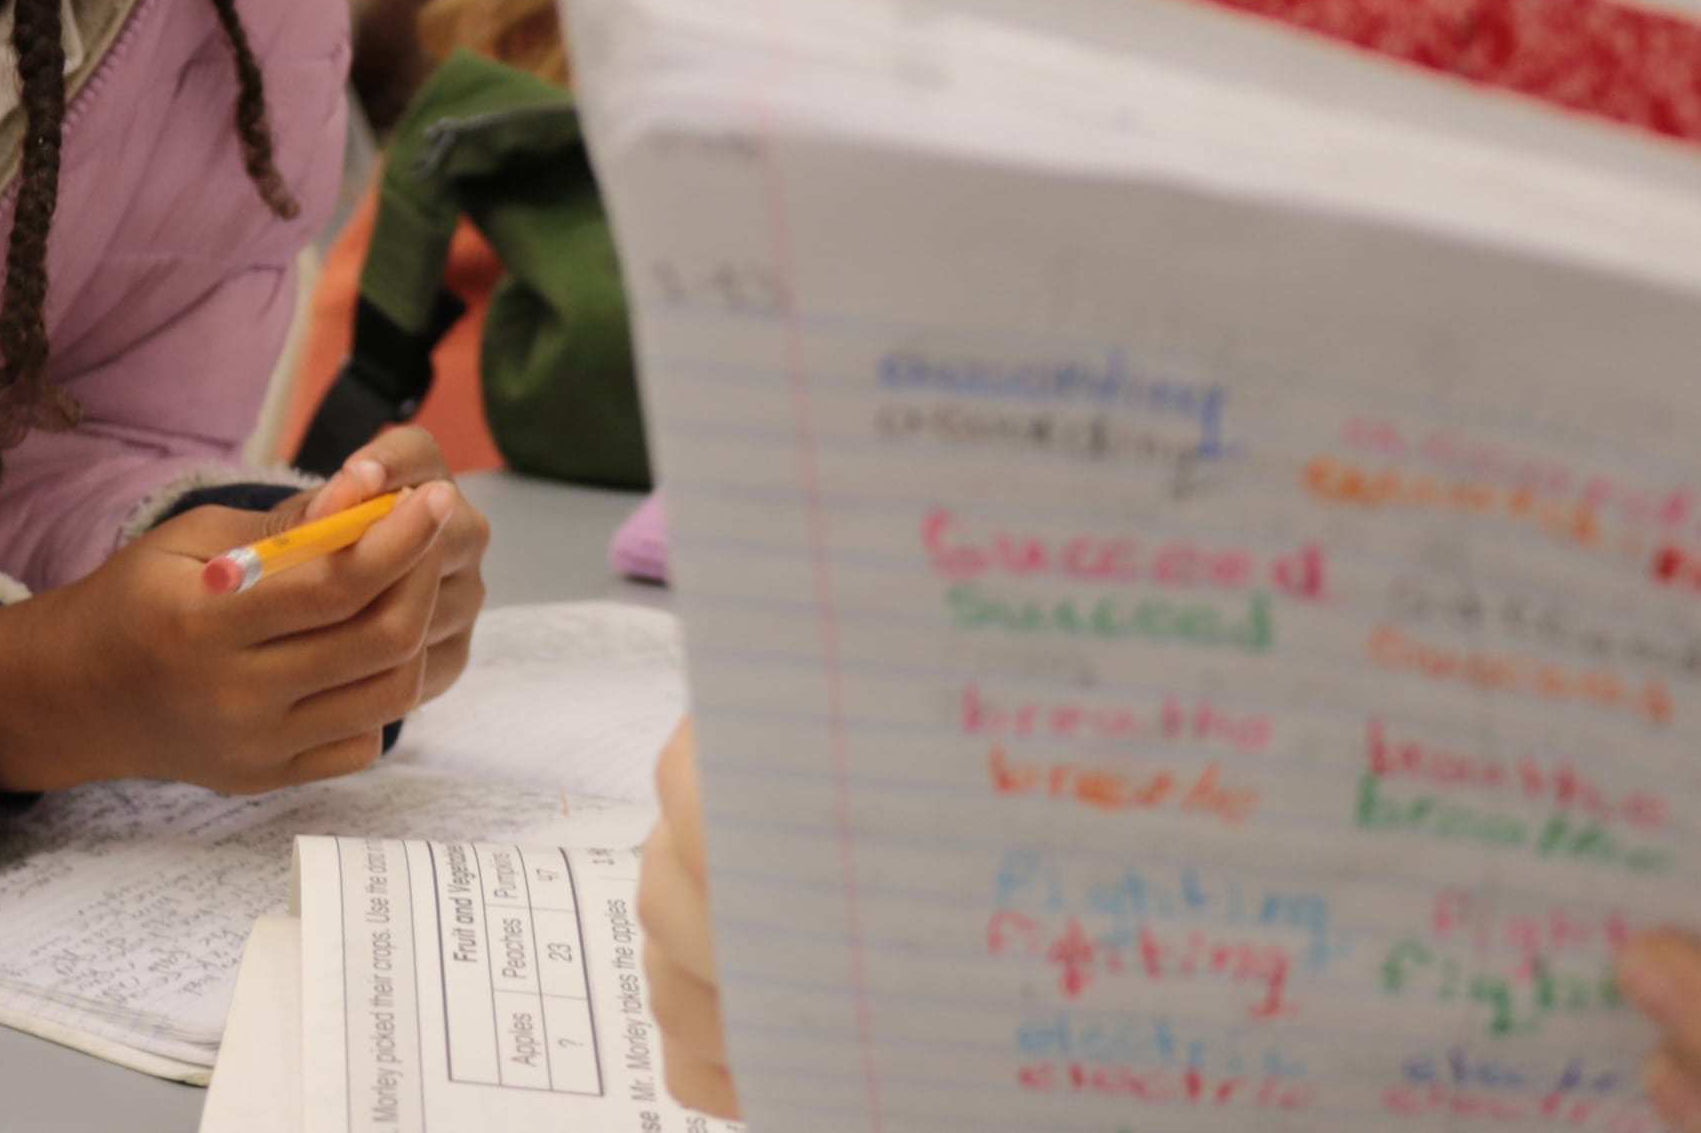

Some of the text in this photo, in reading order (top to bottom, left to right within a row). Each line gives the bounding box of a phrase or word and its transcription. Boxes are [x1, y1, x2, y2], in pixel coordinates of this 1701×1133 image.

[364, 875, 388, 895] the
[365, 897, 390, 923] Use
[452, 896, 474, 926] and
[604, 898, 638, 944] apples
[372, 927, 398, 972] crops.
[452, 928, 479, 963] Fruit
[500, 917, 527, 980] Peaches
[547, 941, 573, 963] 23
[611, 942, 635, 971] the
[367, 976, 394, 1008] their
[616, 973, 644, 1015] takes
[369, 1011, 400, 1062] picked
[509, 1012, 541, 1067] Apples
[557, 1036, 584, 1050] ?
[622, 1022, 653, 1071] Morley
[372, 1062, 403, 1123] Morley
[629, 1074, 658, 1102] Mr.
